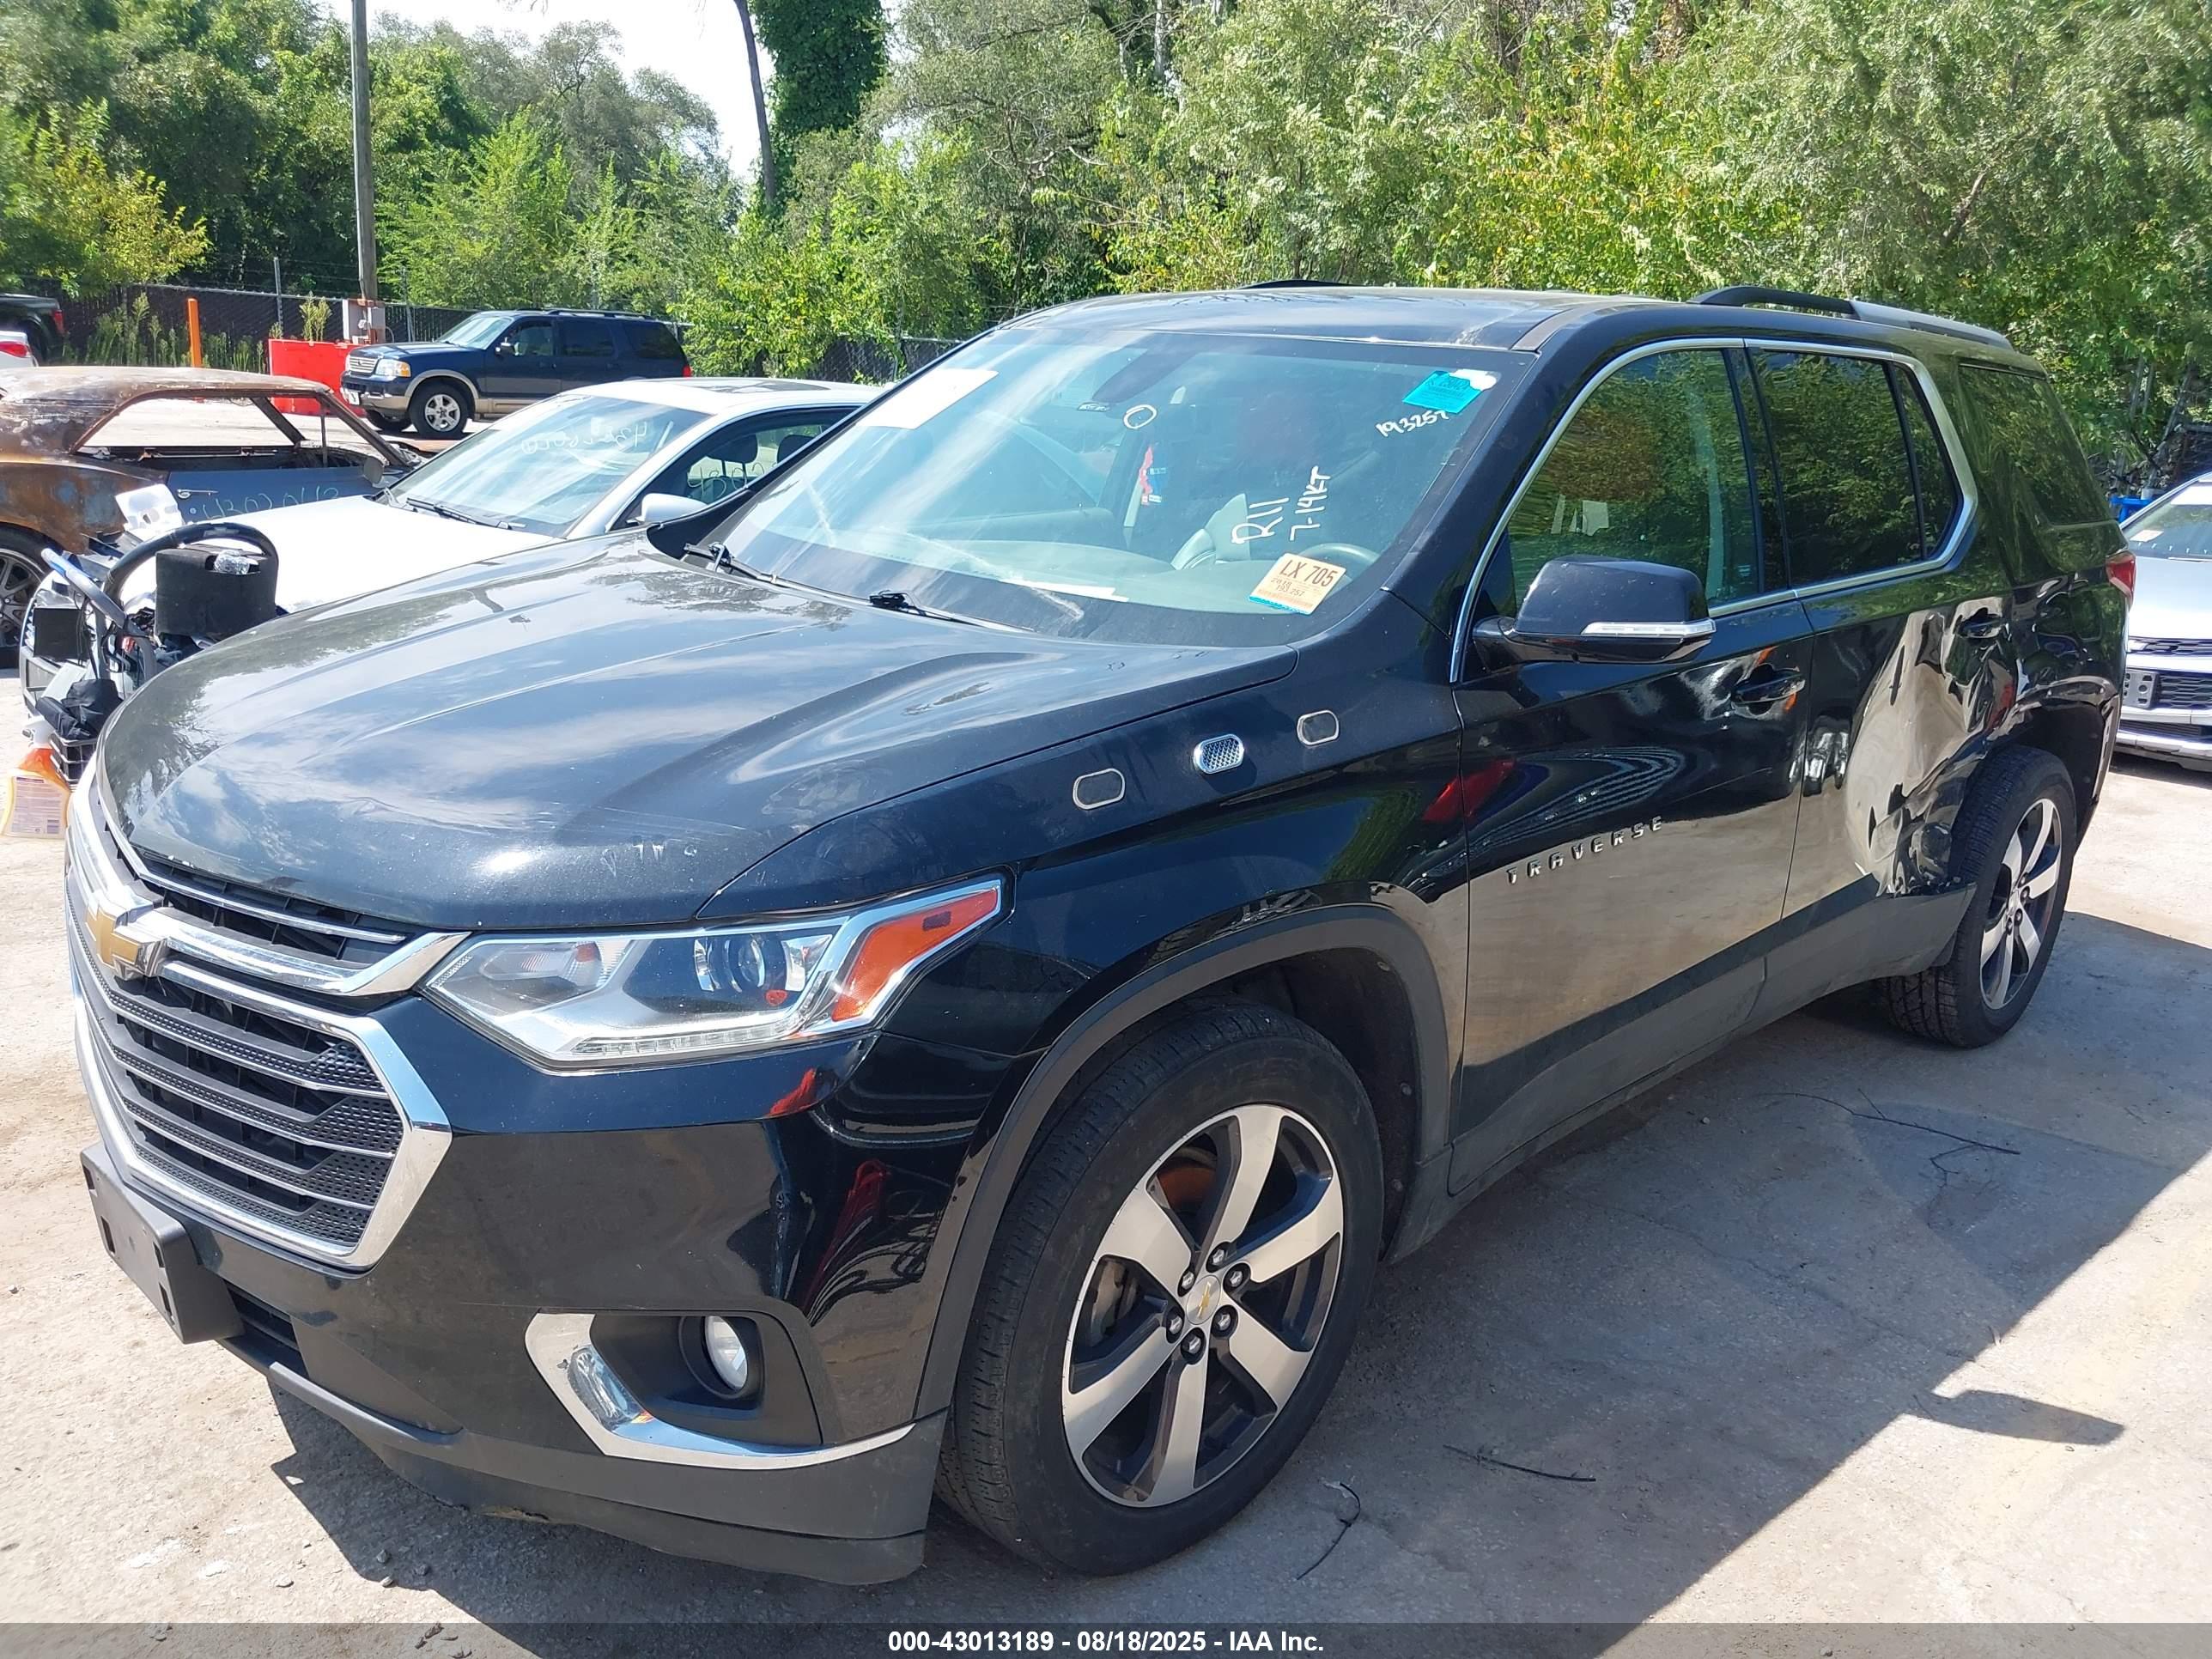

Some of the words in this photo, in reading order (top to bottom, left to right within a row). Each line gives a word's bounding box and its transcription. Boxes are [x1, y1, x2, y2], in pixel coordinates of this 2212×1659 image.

[1376, 410, 1449, 437] 193257
[1279, 559, 1307, 579] LX
[1304, 565, 1338, 587] 705
[1506, 815, 1662, 884] TRAVERSE
